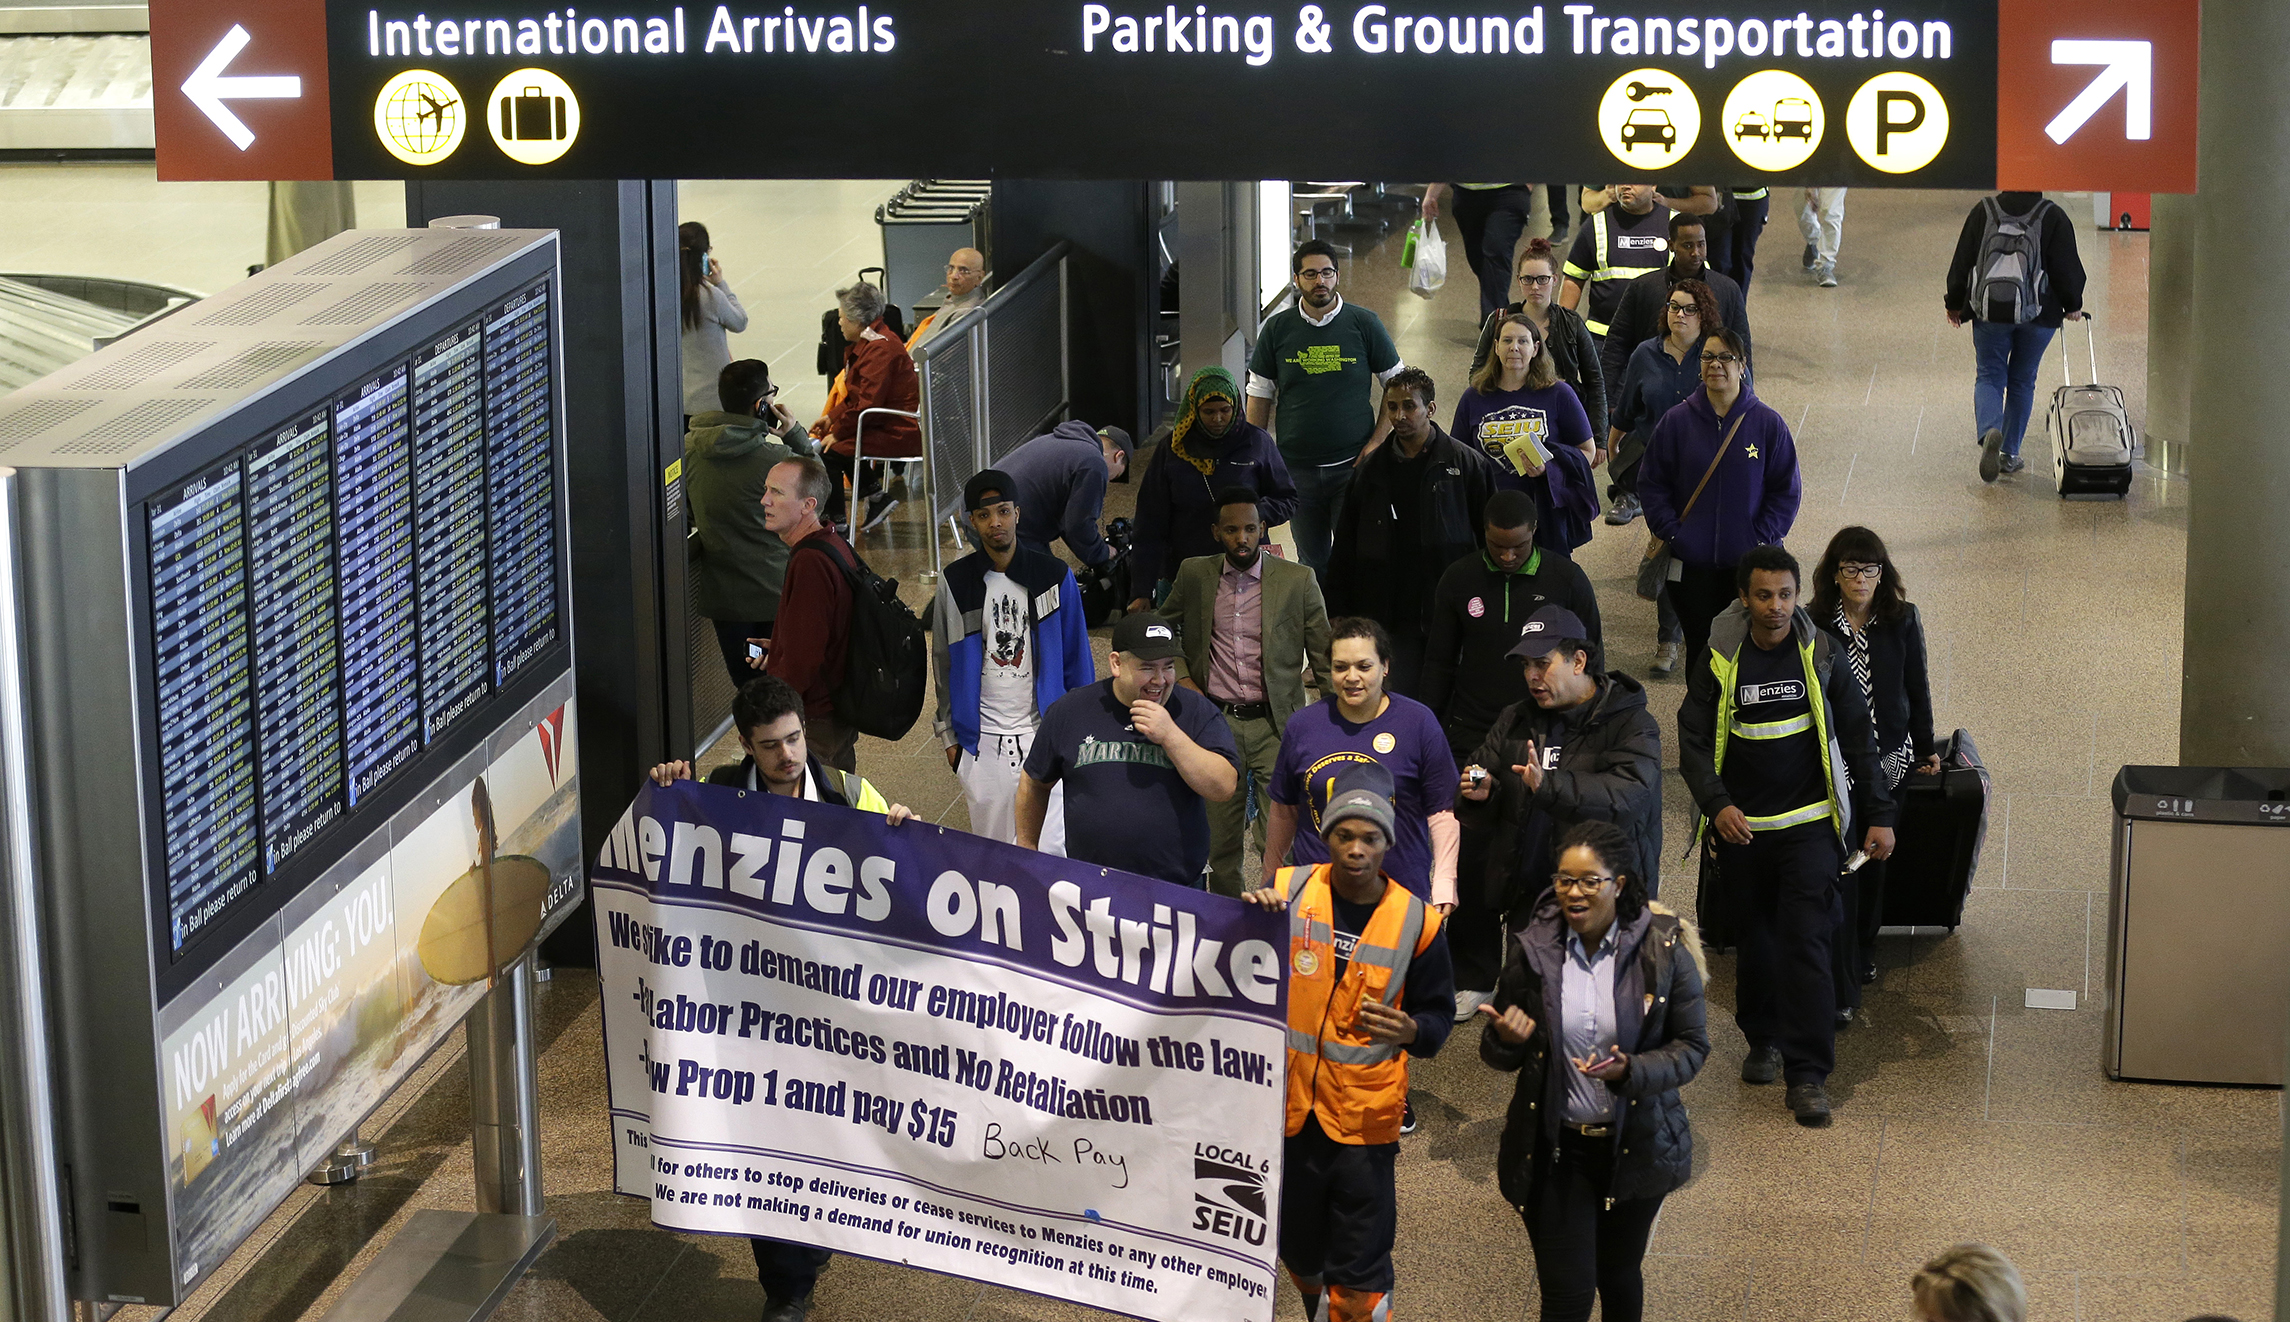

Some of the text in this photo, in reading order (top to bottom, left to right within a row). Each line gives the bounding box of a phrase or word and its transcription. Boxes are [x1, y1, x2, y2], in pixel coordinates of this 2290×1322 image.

[368, 5, 896, 56] International Arrivals
[1084, 5, 1952, 68] Parking & Ground Transportation
[360, 376, 380, 399] ARRIVALS
[276, 423, 298, 447] ARRIVALS
[1484, 420, 1541, 435] SEIU
[182, 475, 206, 501] ARRIVALS
[506, 653, 516, 675] Ball
[517, 645, 532, 671] please
[533, 632, 548, 653] return
[549, 624, 555, 642] to
[435, 709, 446, 733] Ball
[446, 699, 463, 727] please
[464, 686, 480, 708] return
[481, 677, 487, 696] to
[1744, 683, 1797, 702] Menzies
[361, 768, 373, 793] Ball
[373, 759, 391, 787] please
[392, 744, 410, 767] return
[410, 735, 417, 755] to
[1074, 741, 1173, 769] MARINER
[1312, 755, 1346, 773] Deserves
[1353, 755, 1371, 764] Saf
[280, 834, 292, 860] Ball
[293, 822, 313, 853] please
[314, 806, 333, 832] return
[333, 796, 341, 817] to
[189, 905, 202, 935] Ball
[203, 892, 225, 927] please
[226, 875, 247, 905] return
[248, 864, 256, 887] to
[548, 875, 574, 911] DELTA
[600, 801, 1281, 1006] Menzies on Strike
[174, 875, 395, 1111] NOW ARRIVING: YOU.
[608, 910, 641, 949] We
[700, 934, 733, 972] to
[740, 940, 863, 1002] demand
[868, 973, 923, 1012] our
[927, 984, 1060, 1041] employer
[1060, 1013, 1140, 1068] follow
[1147, 1036, 1203, 1072] the
[1210, 1039, 1273, 1088] law:
[222, 1076, 239, 1100] Apply
[239, 1067, 248, 1084] for
[248, 1057, 259, 1077] the
[257, 1043, 272, 1069] Card
[271, 1036, 283, 1057] and
[291, 1001, 319, 1040] Discounted
[318, 996, 328, 1014] Sky
[738, 1002, 887, 1065] Practices
[893, 1040, 951, 1083] and
[954, 1048, 994, 1092] No
[994, 1059, 1153, 1126] Retaliation
[224, 1097, 243, 1125] access
[242, 1091, 251, 1108] on
[250, 1082, 264, 1104] your
[263, 1066, 277, 1092] next
[276, 1057, 288, 1078] trip
[292, 1044, 302, 1062] Los
[676, 1059, 756, 1106] Prop
[763, 1069, 779, 1107] 1
[784, 1077, 847, 1118] and
[853, 1089, 904, 1135] pay
[907, 1097, 958, 1149] $15
[225, 1125, 243, 1149] Learn
[241, 1111, 257, 1135] more
[256, 1104, 263, 1121] at
[627, 1129, 649, 1149] This
[983, 1122, 1129, 1190] Back Pay
[1193, 1142, 1271, 1174] LOCAL 6
[655, 1182, 1159, 1294] We are not making a demand for union recognition at this time.
[658, 1157, 679, 1176] for
[684, 1161, 738, 1182] others
[744, 1166, 762, 1184] to
[767, 1172, 804, 1194] stop
[809, 1176, 888, 1207] deliveries
[891, 1192, 910, 1209] or
[913, 1199, 954, 1221] cease
[958, 1208, 1017, 1237] services
[1020, 1223, 1037, 1240] to
[1042, 1226, 1104, 1253] Menzies
[1108, 1242, 1125, 1259] or
[1128, 1249, 1157, 1270] any
[1161, 1253, 1203, 1278] other
[1192, 1206, 1268, 1247] SEIU
